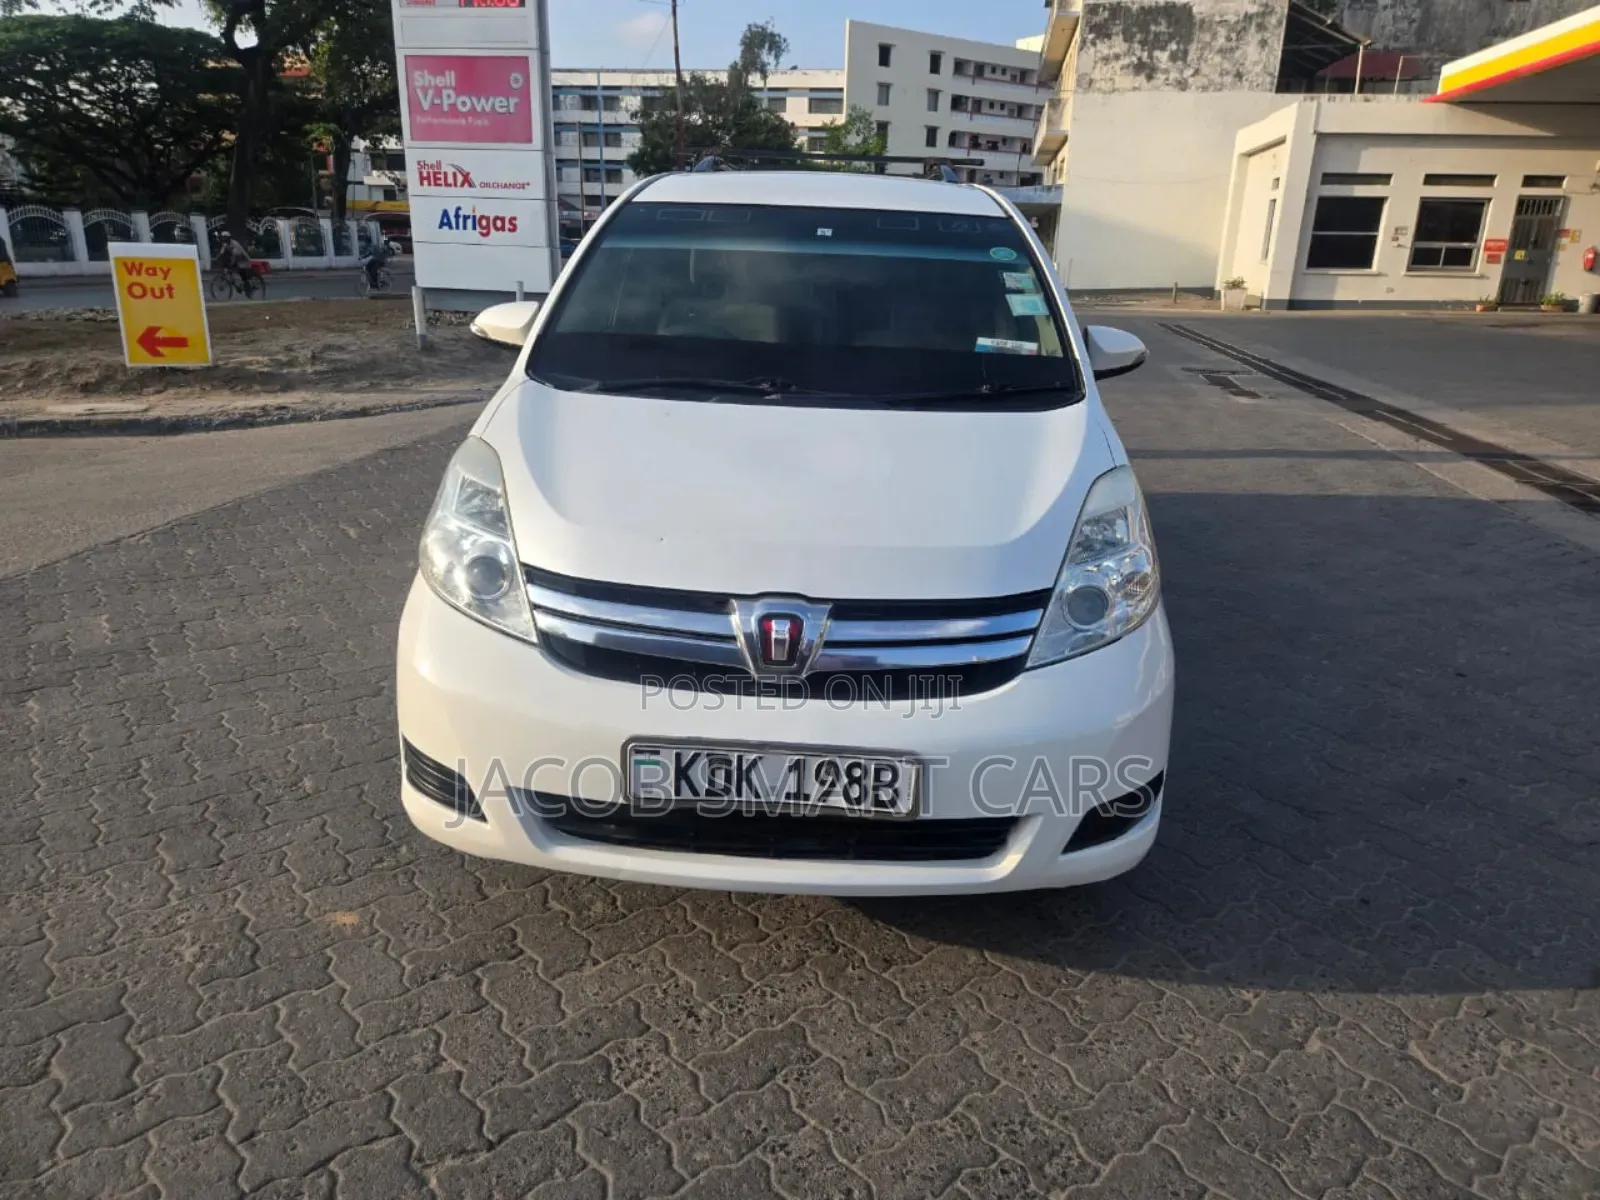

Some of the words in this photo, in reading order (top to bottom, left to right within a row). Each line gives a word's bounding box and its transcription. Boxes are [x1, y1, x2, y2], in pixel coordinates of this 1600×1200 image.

[414, 69, 456, 87] Shell
[415, 88, 519, 113] V-Power
[417, 160, 442, 170] Shell
[418, 170, 473, 188] HELIX
[438, 205, 518, 237] Afrigas
[122, 261, 171, 280] Way
[126, 282, 175, 299] Out
[674, 751, 763, 799] KDK
[784, 757, 900, 809] 198B
